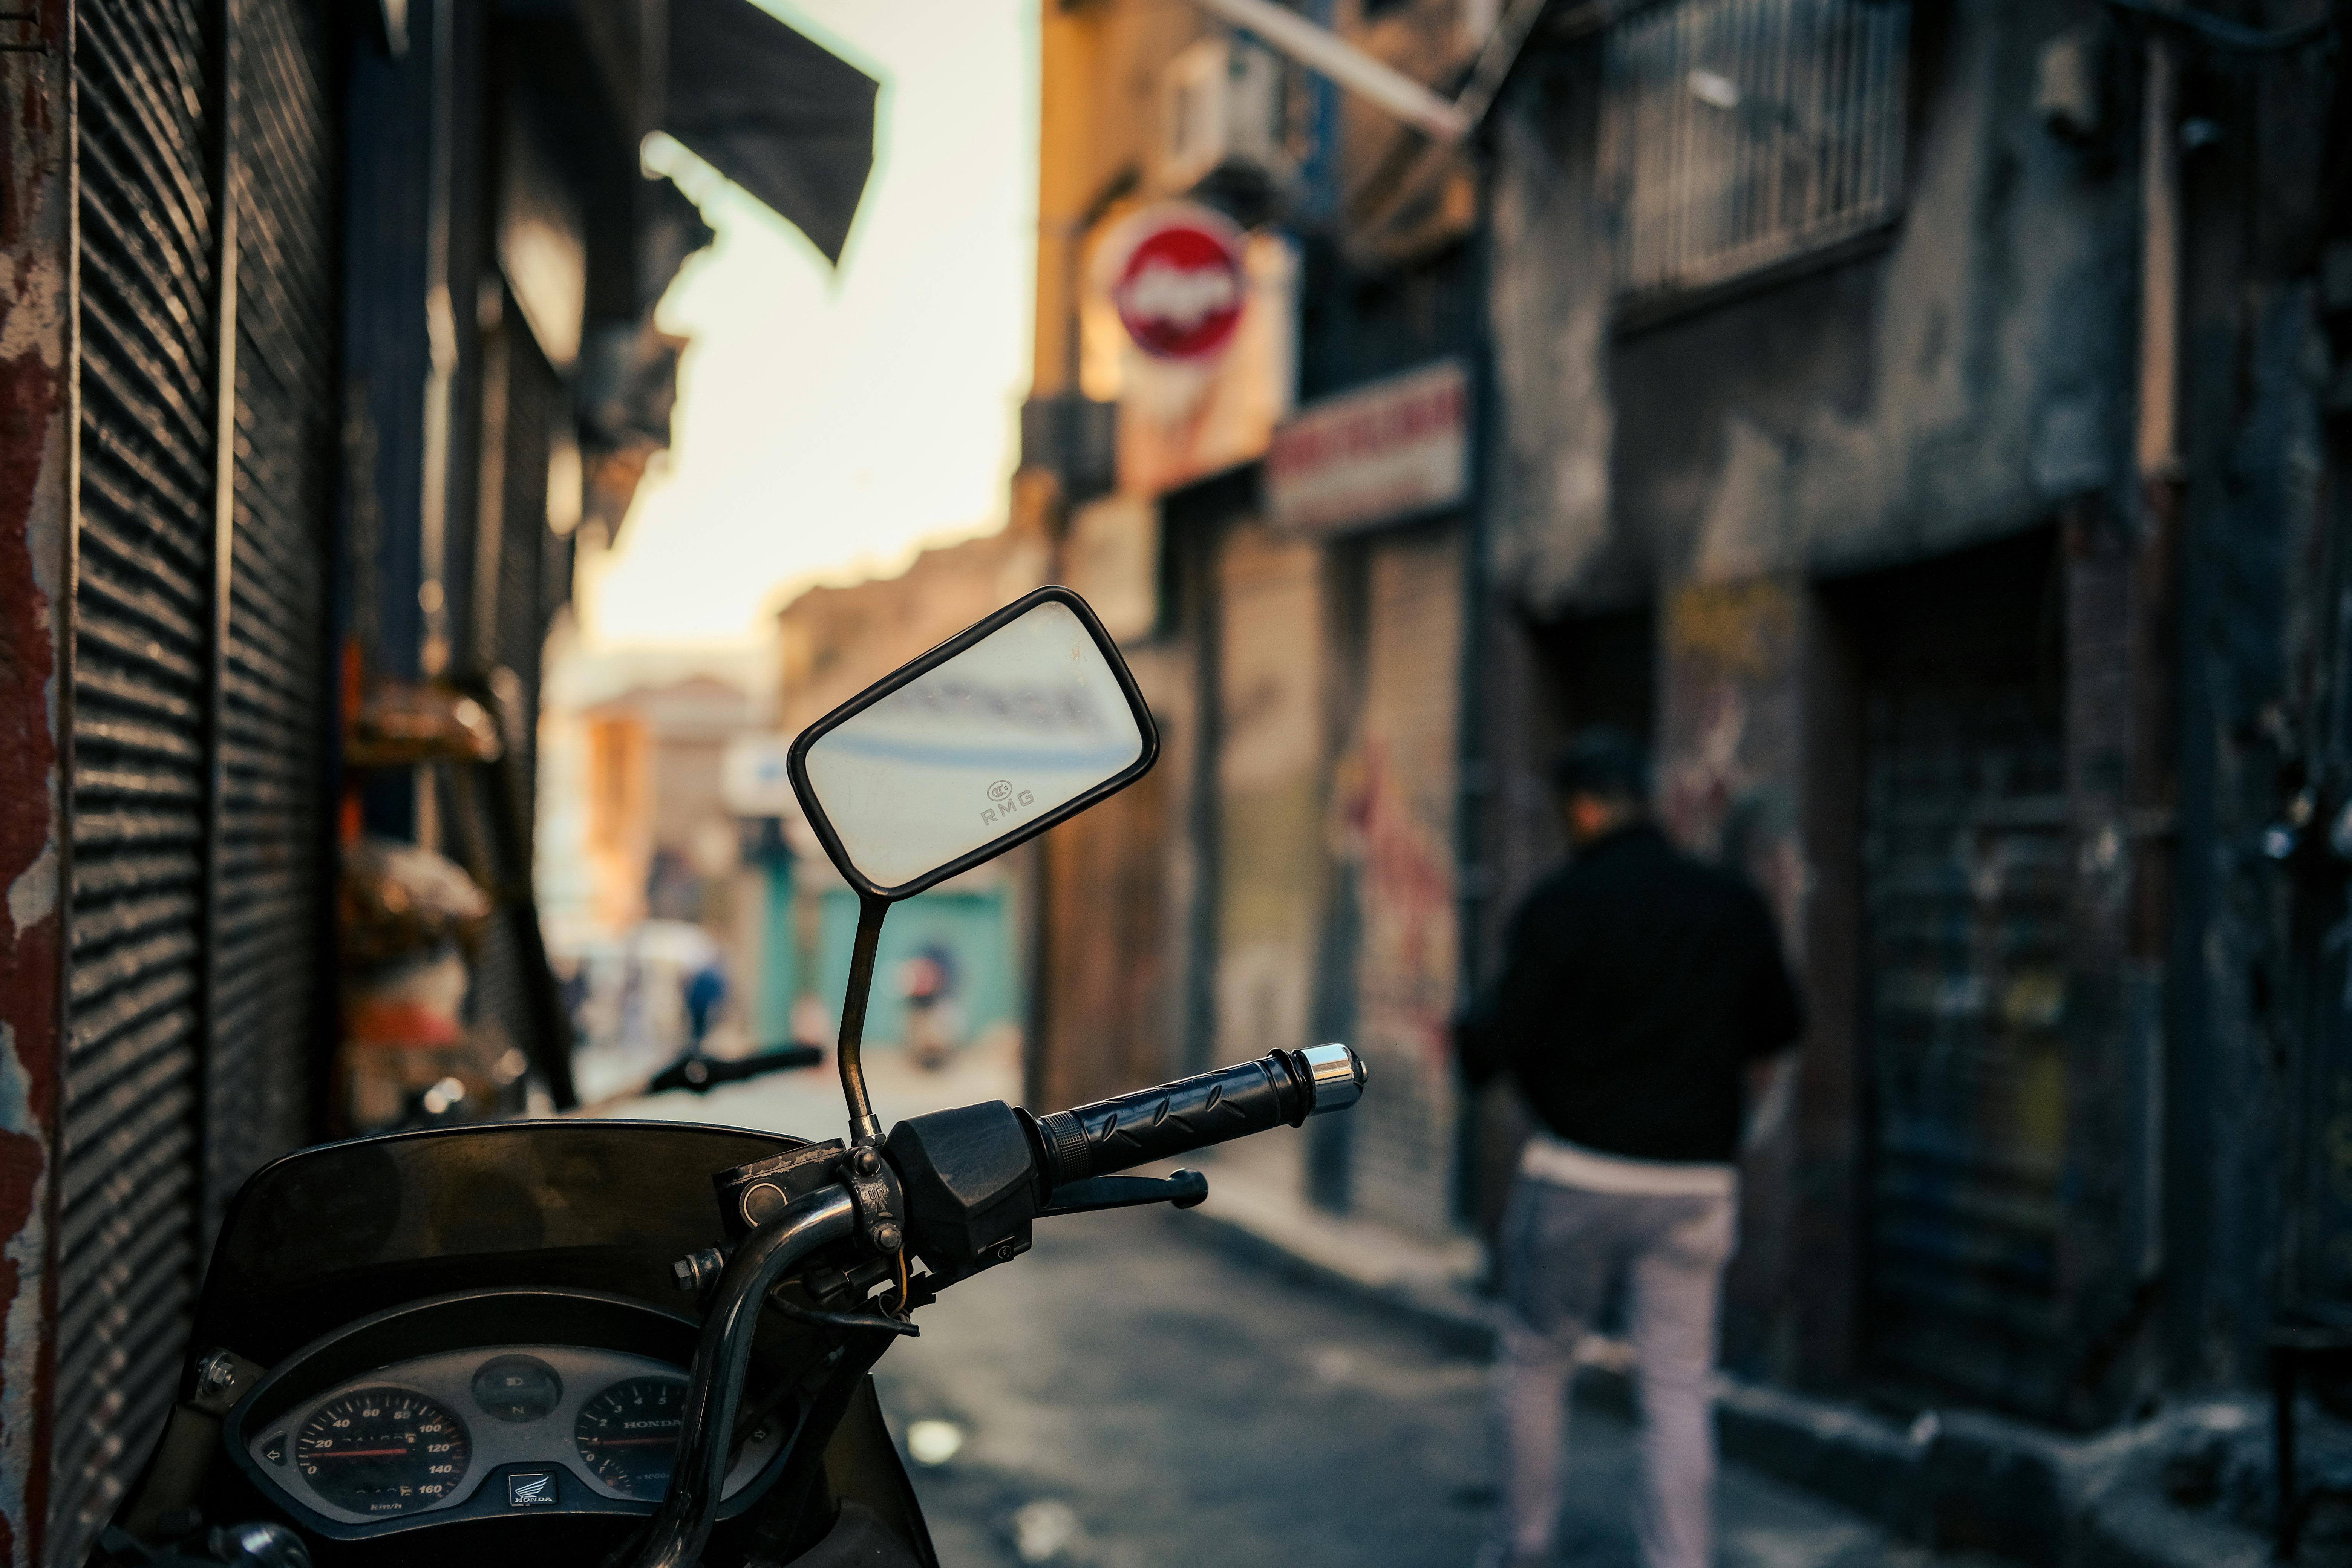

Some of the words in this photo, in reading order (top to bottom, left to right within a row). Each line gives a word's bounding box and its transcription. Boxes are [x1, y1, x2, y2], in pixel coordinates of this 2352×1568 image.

[980, 789, 1035, 826] RMG
[868, 1188, 884, 1200] UP
[362, 1408, 380, 1417] 60
[332, 1419, 350, 1427] 40
[624, 1419, 681, 1429] HONDA
[420, 1424, 441, 1433] 100
[427, 1444, 450, 1452] 120
[586, 1453, 595, 1462] 0
[308, 1465, 317, 1475] 0
[429, 1465, 452, 1474] 140
[419, 1485, 443, 1494] 160
